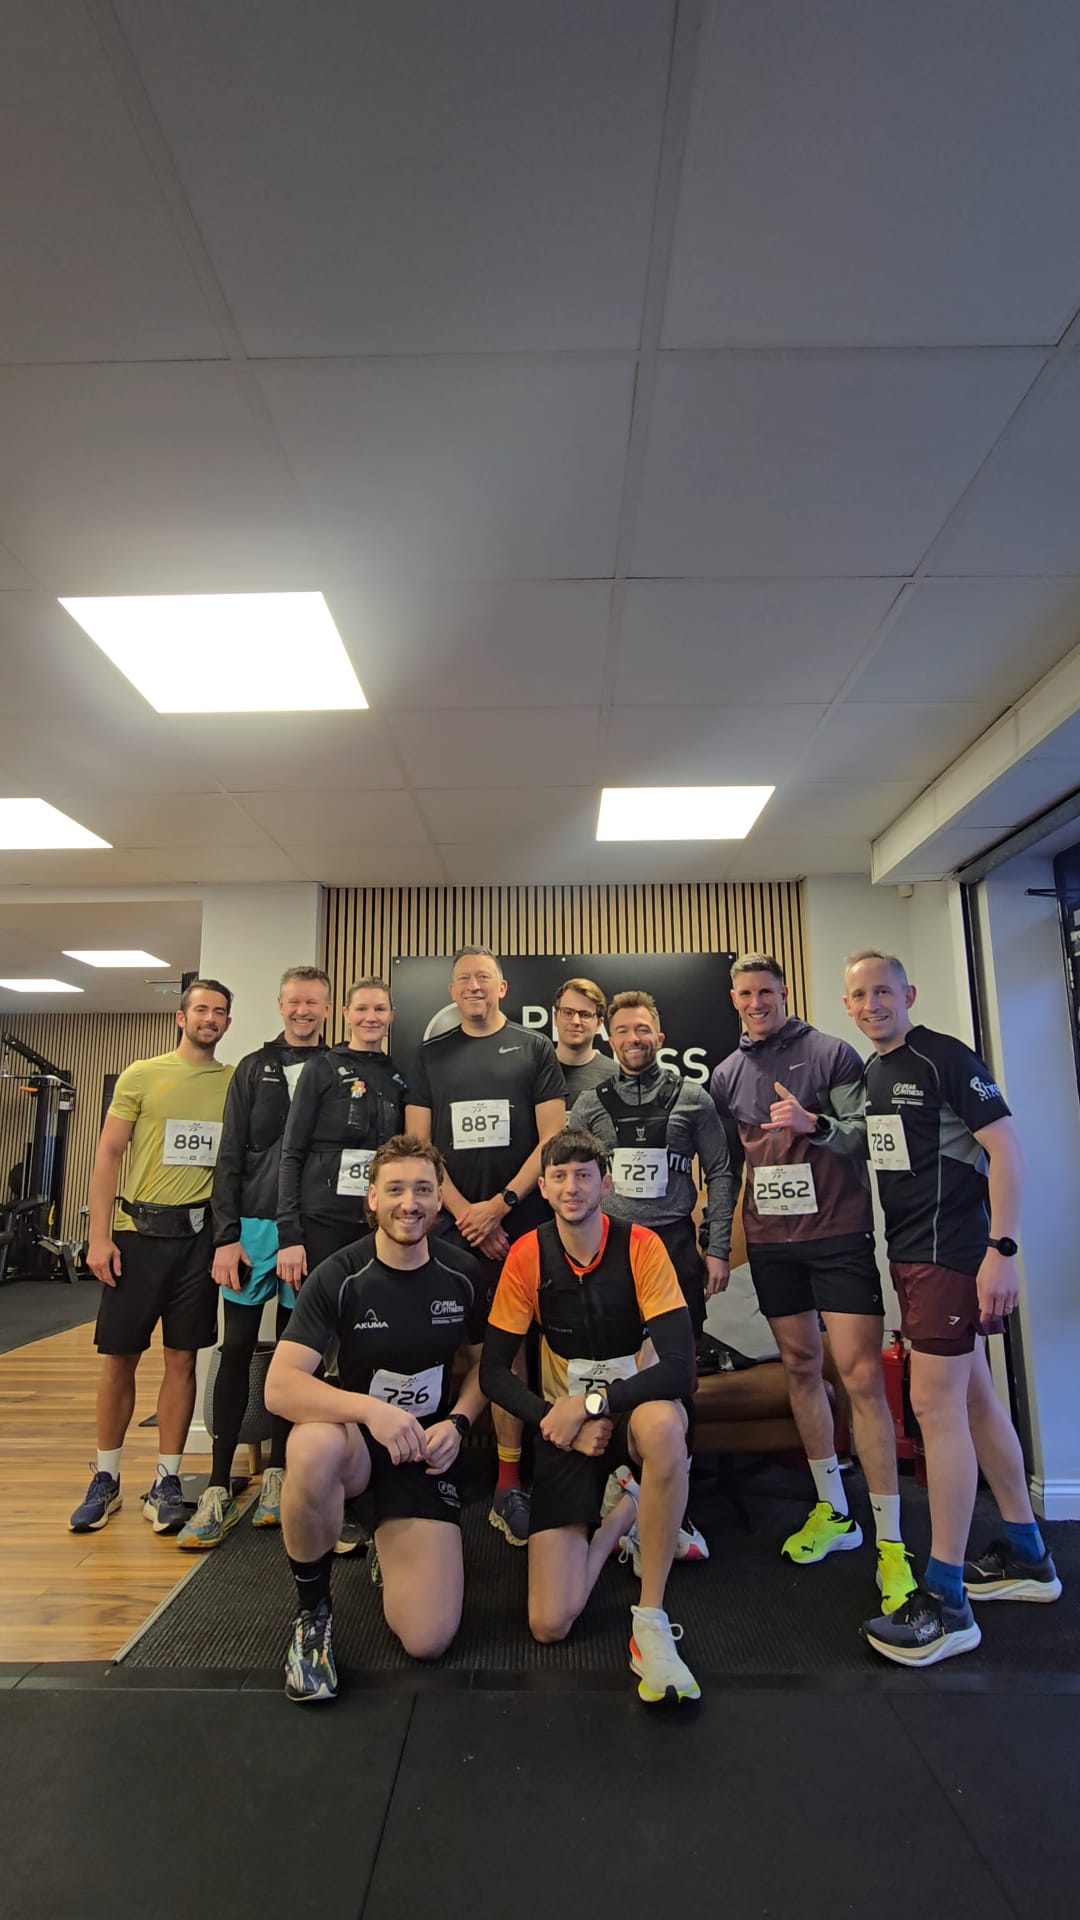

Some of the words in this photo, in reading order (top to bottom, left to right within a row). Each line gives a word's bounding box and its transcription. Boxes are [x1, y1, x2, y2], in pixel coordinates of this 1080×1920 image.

[462, 1114, 500, 1132] 887
[174, 1134, 213, 1151] 884
[871, 1133, 896, 1152] 728
[349, 1163, 370, 1180] 88
[621, 1164, 659, 1181] 727
[757, 1180, 811, 1200] 2562
[353, 1321, 389, 1330] AKUMA
[384, 1385, 430, 1406] 726
